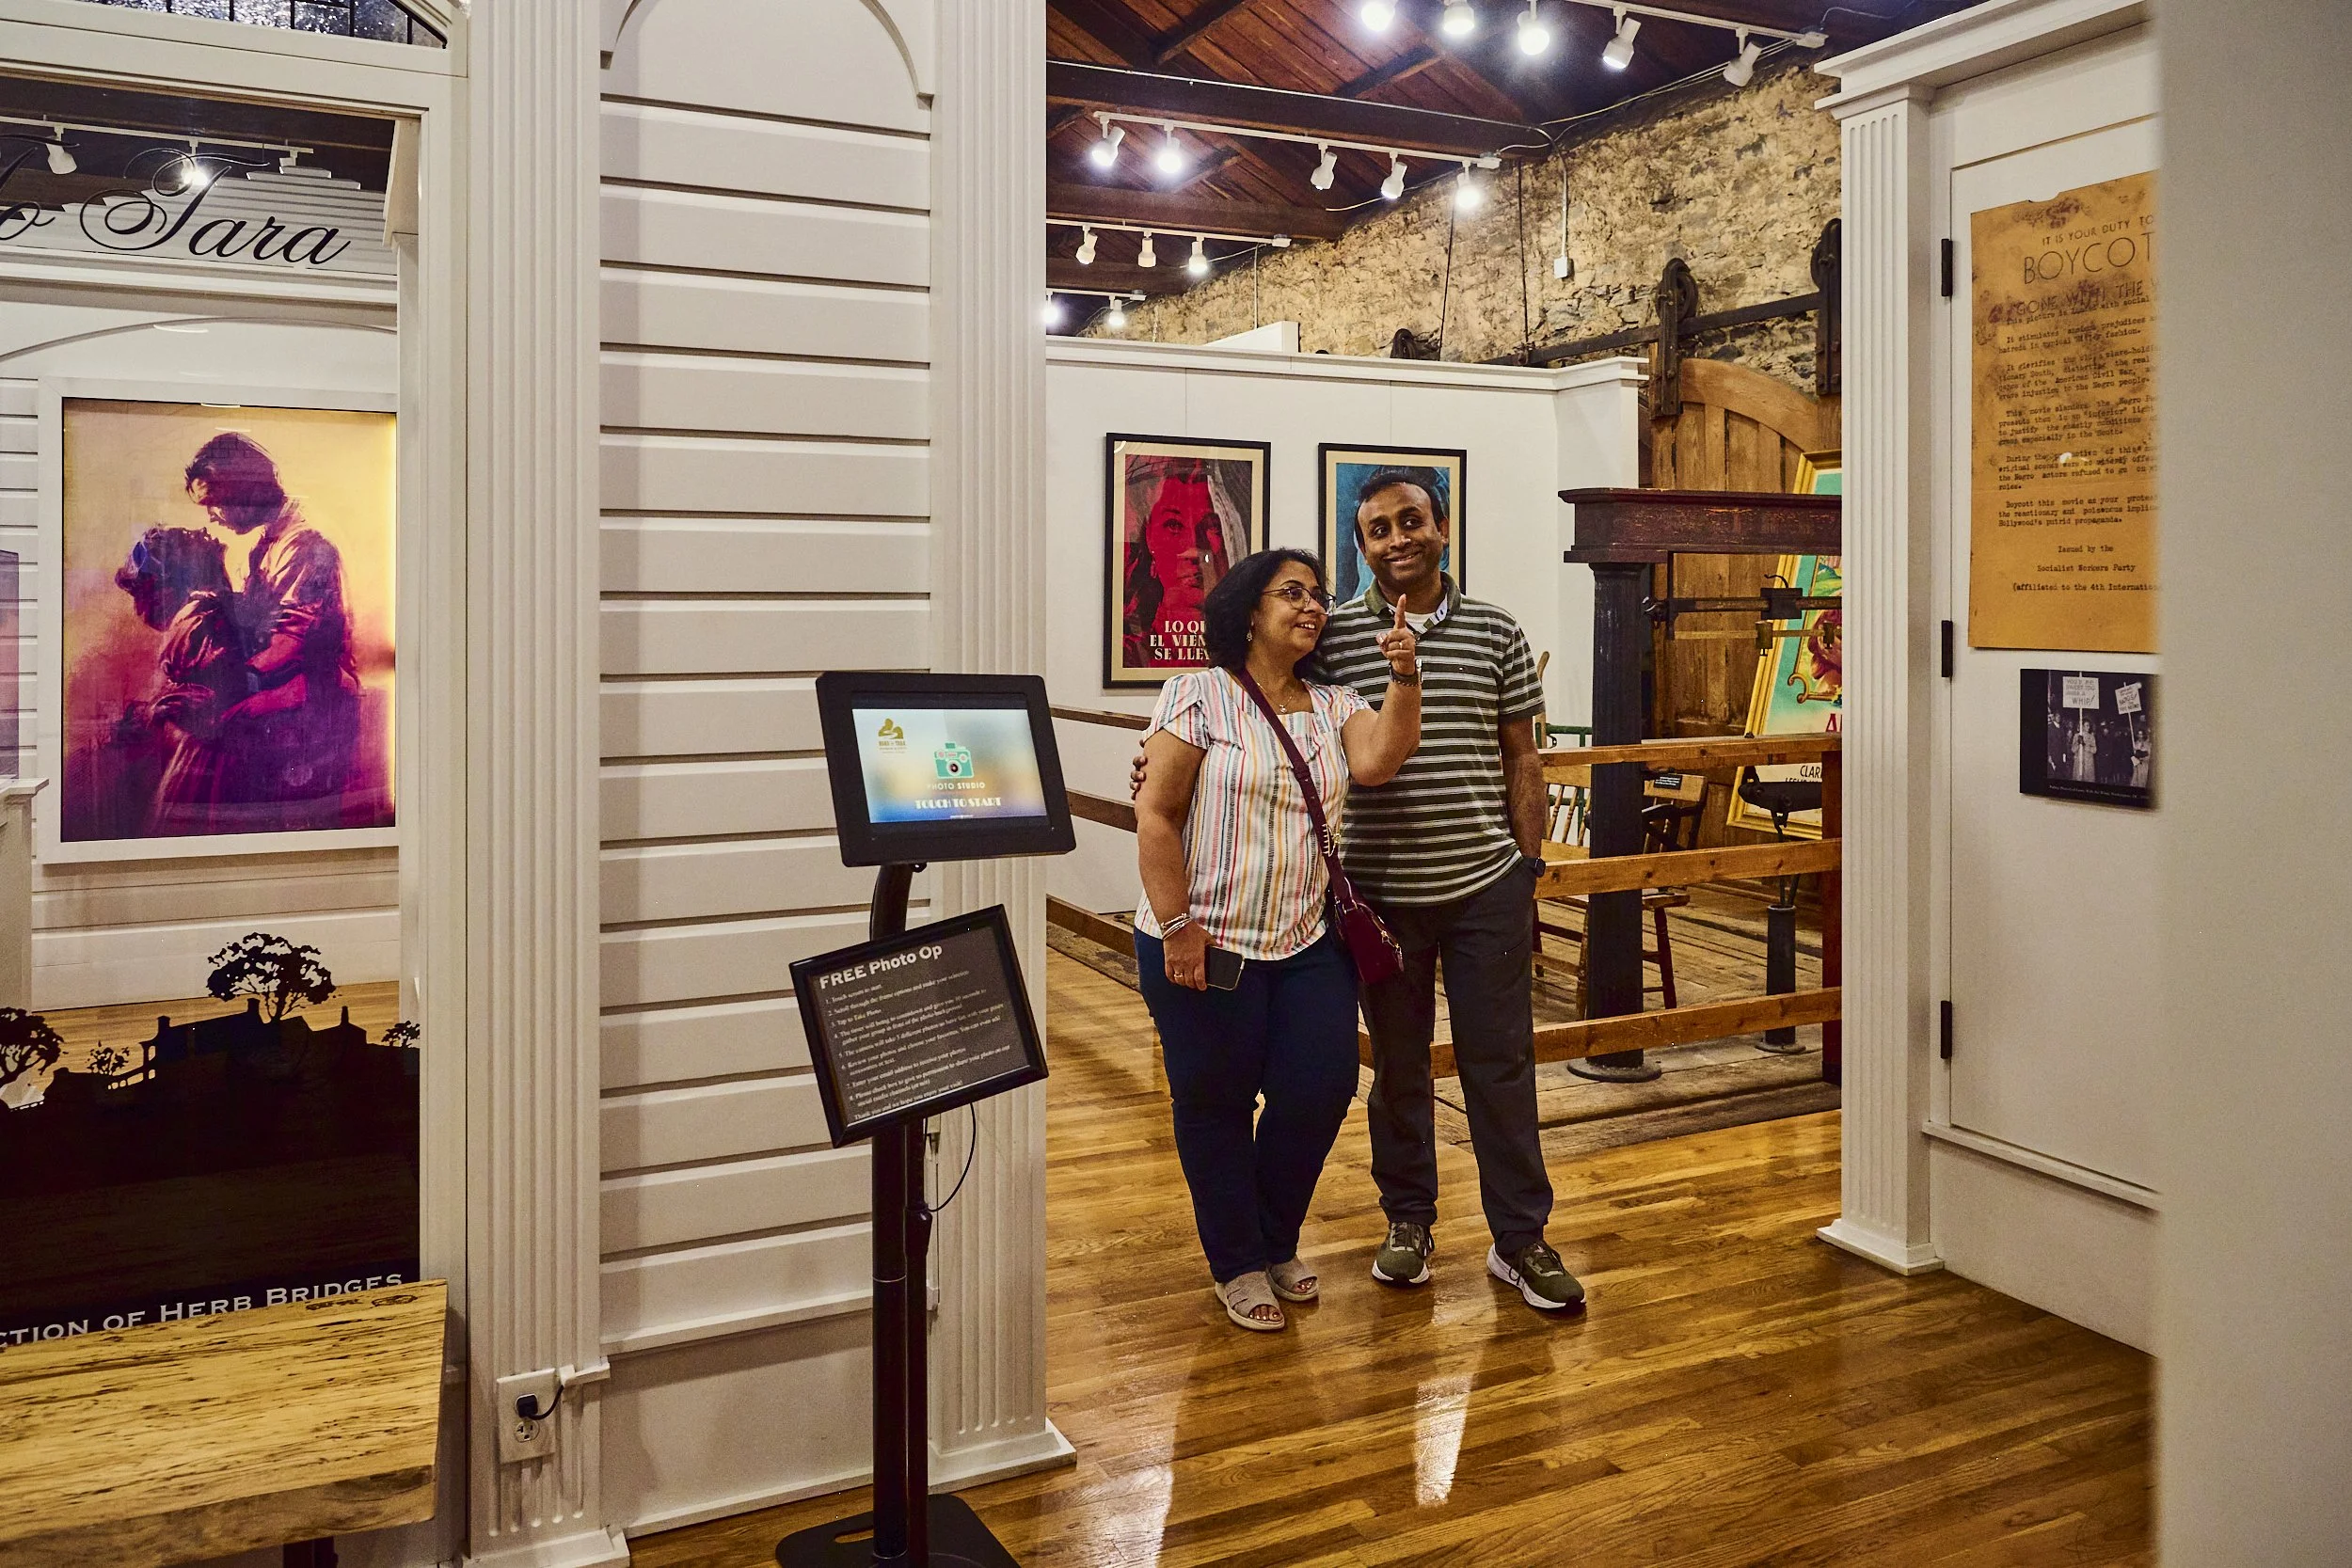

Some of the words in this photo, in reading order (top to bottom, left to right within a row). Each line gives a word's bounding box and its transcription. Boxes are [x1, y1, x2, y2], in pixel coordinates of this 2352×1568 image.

[80, 148, 352, 264] Tara
[2069, 227, 2096, 240] YOUR
[2115, 279, 2142, 299] THE
[2100, 315, 2145, 330] prejudices
[2006, 499, 2033, 509] Boycott
[2100, 496, 2119, 504] your
[1998, 516, 2042, 528] Hollywood's
[2045, 517, 2071, 526] putrid
[2074, 515, 2122, 526] propaganda.
[2087, 544, 2096, 553] by
[2100, 544, 2114, 552] the
[2036, 563, 2074, 573] Socialist
[2077, 562, 2108, 572] Workers
[2112, 562, 2136, 572] Party
[1165, 620, 1184, 633] LO
[1150, 634, 1165, 647] EL
[1154, 647, 1172, 660] SE
[1826, 713, 1842, 732] A
[1800, 765, 1822, 779] CLAR
[957, 782, 986, 790] STUDIO
[914, 799, 951, 810] TOUCH
[952, 798, 968, 809] TO
[968, 797, 1002, 808] START
[819, 965, 867, 990] FREE
[868, 950, 917, 975] Photo
[918, 944, 943, 960] Op
[103, 1310, 146, 1331] OF
